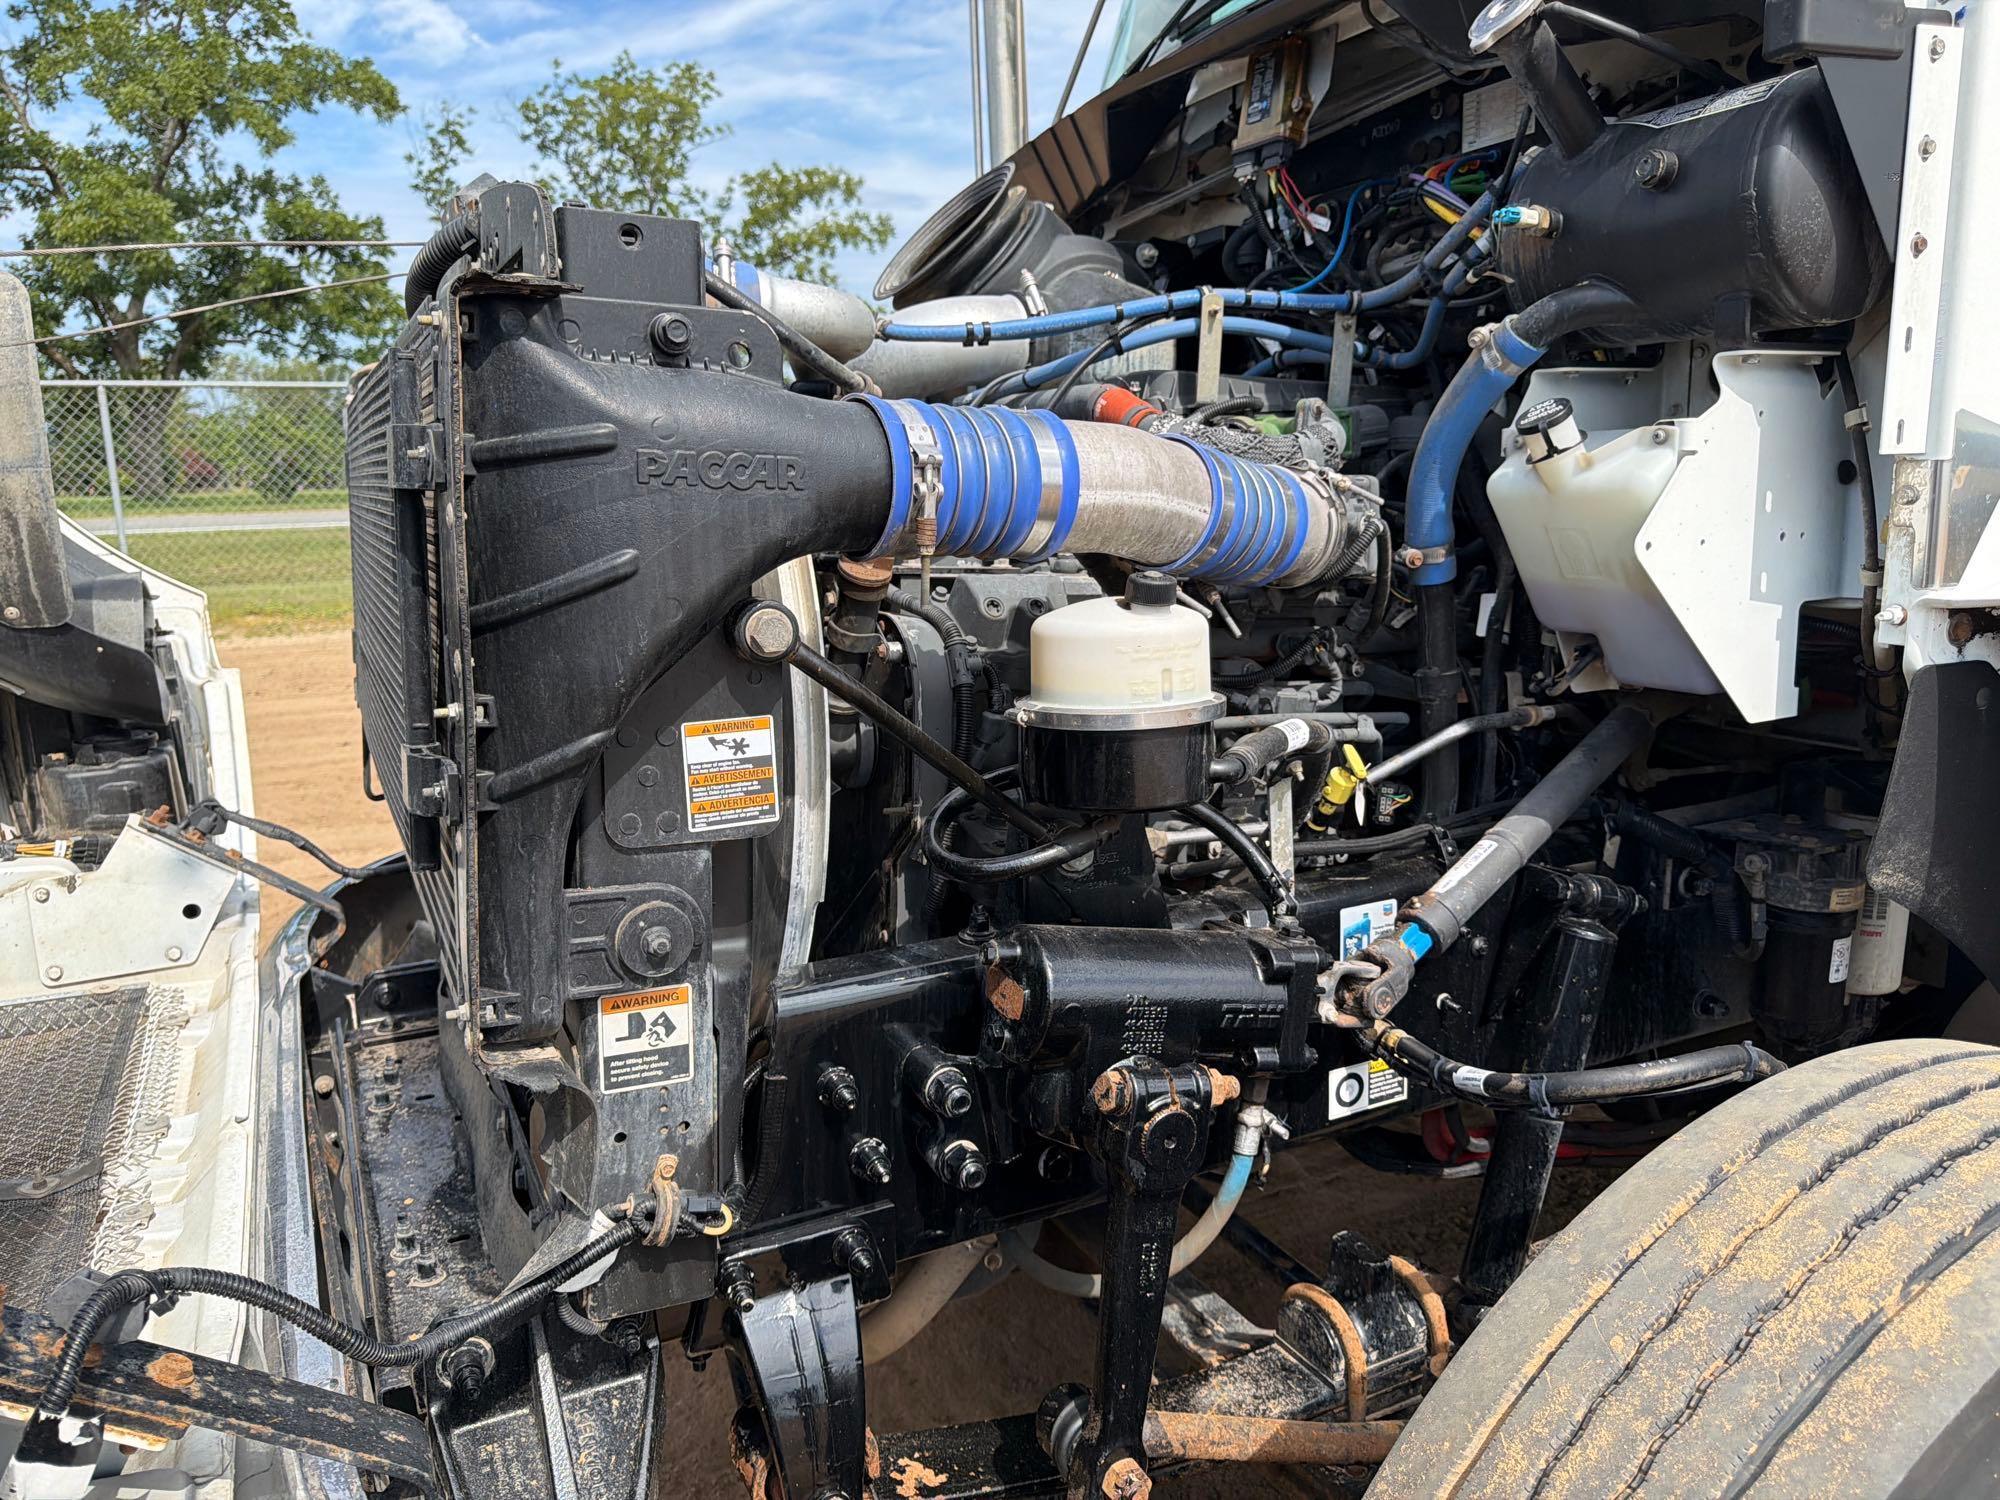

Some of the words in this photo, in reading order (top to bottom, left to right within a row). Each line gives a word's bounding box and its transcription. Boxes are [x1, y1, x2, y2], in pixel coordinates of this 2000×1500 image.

[636, 448, 805, 491] PACCAR
[712, 720, 755, 732] WARNING
[703, 768, 771, 784] AVERTISSEMENT
[709, 795, 770, 810] ADVERTENCIA
[621, 992, 679, 1008] WARNING
[631, 1064, 650, 1072] safety
[618, 1073, 640, 1083] prevent
